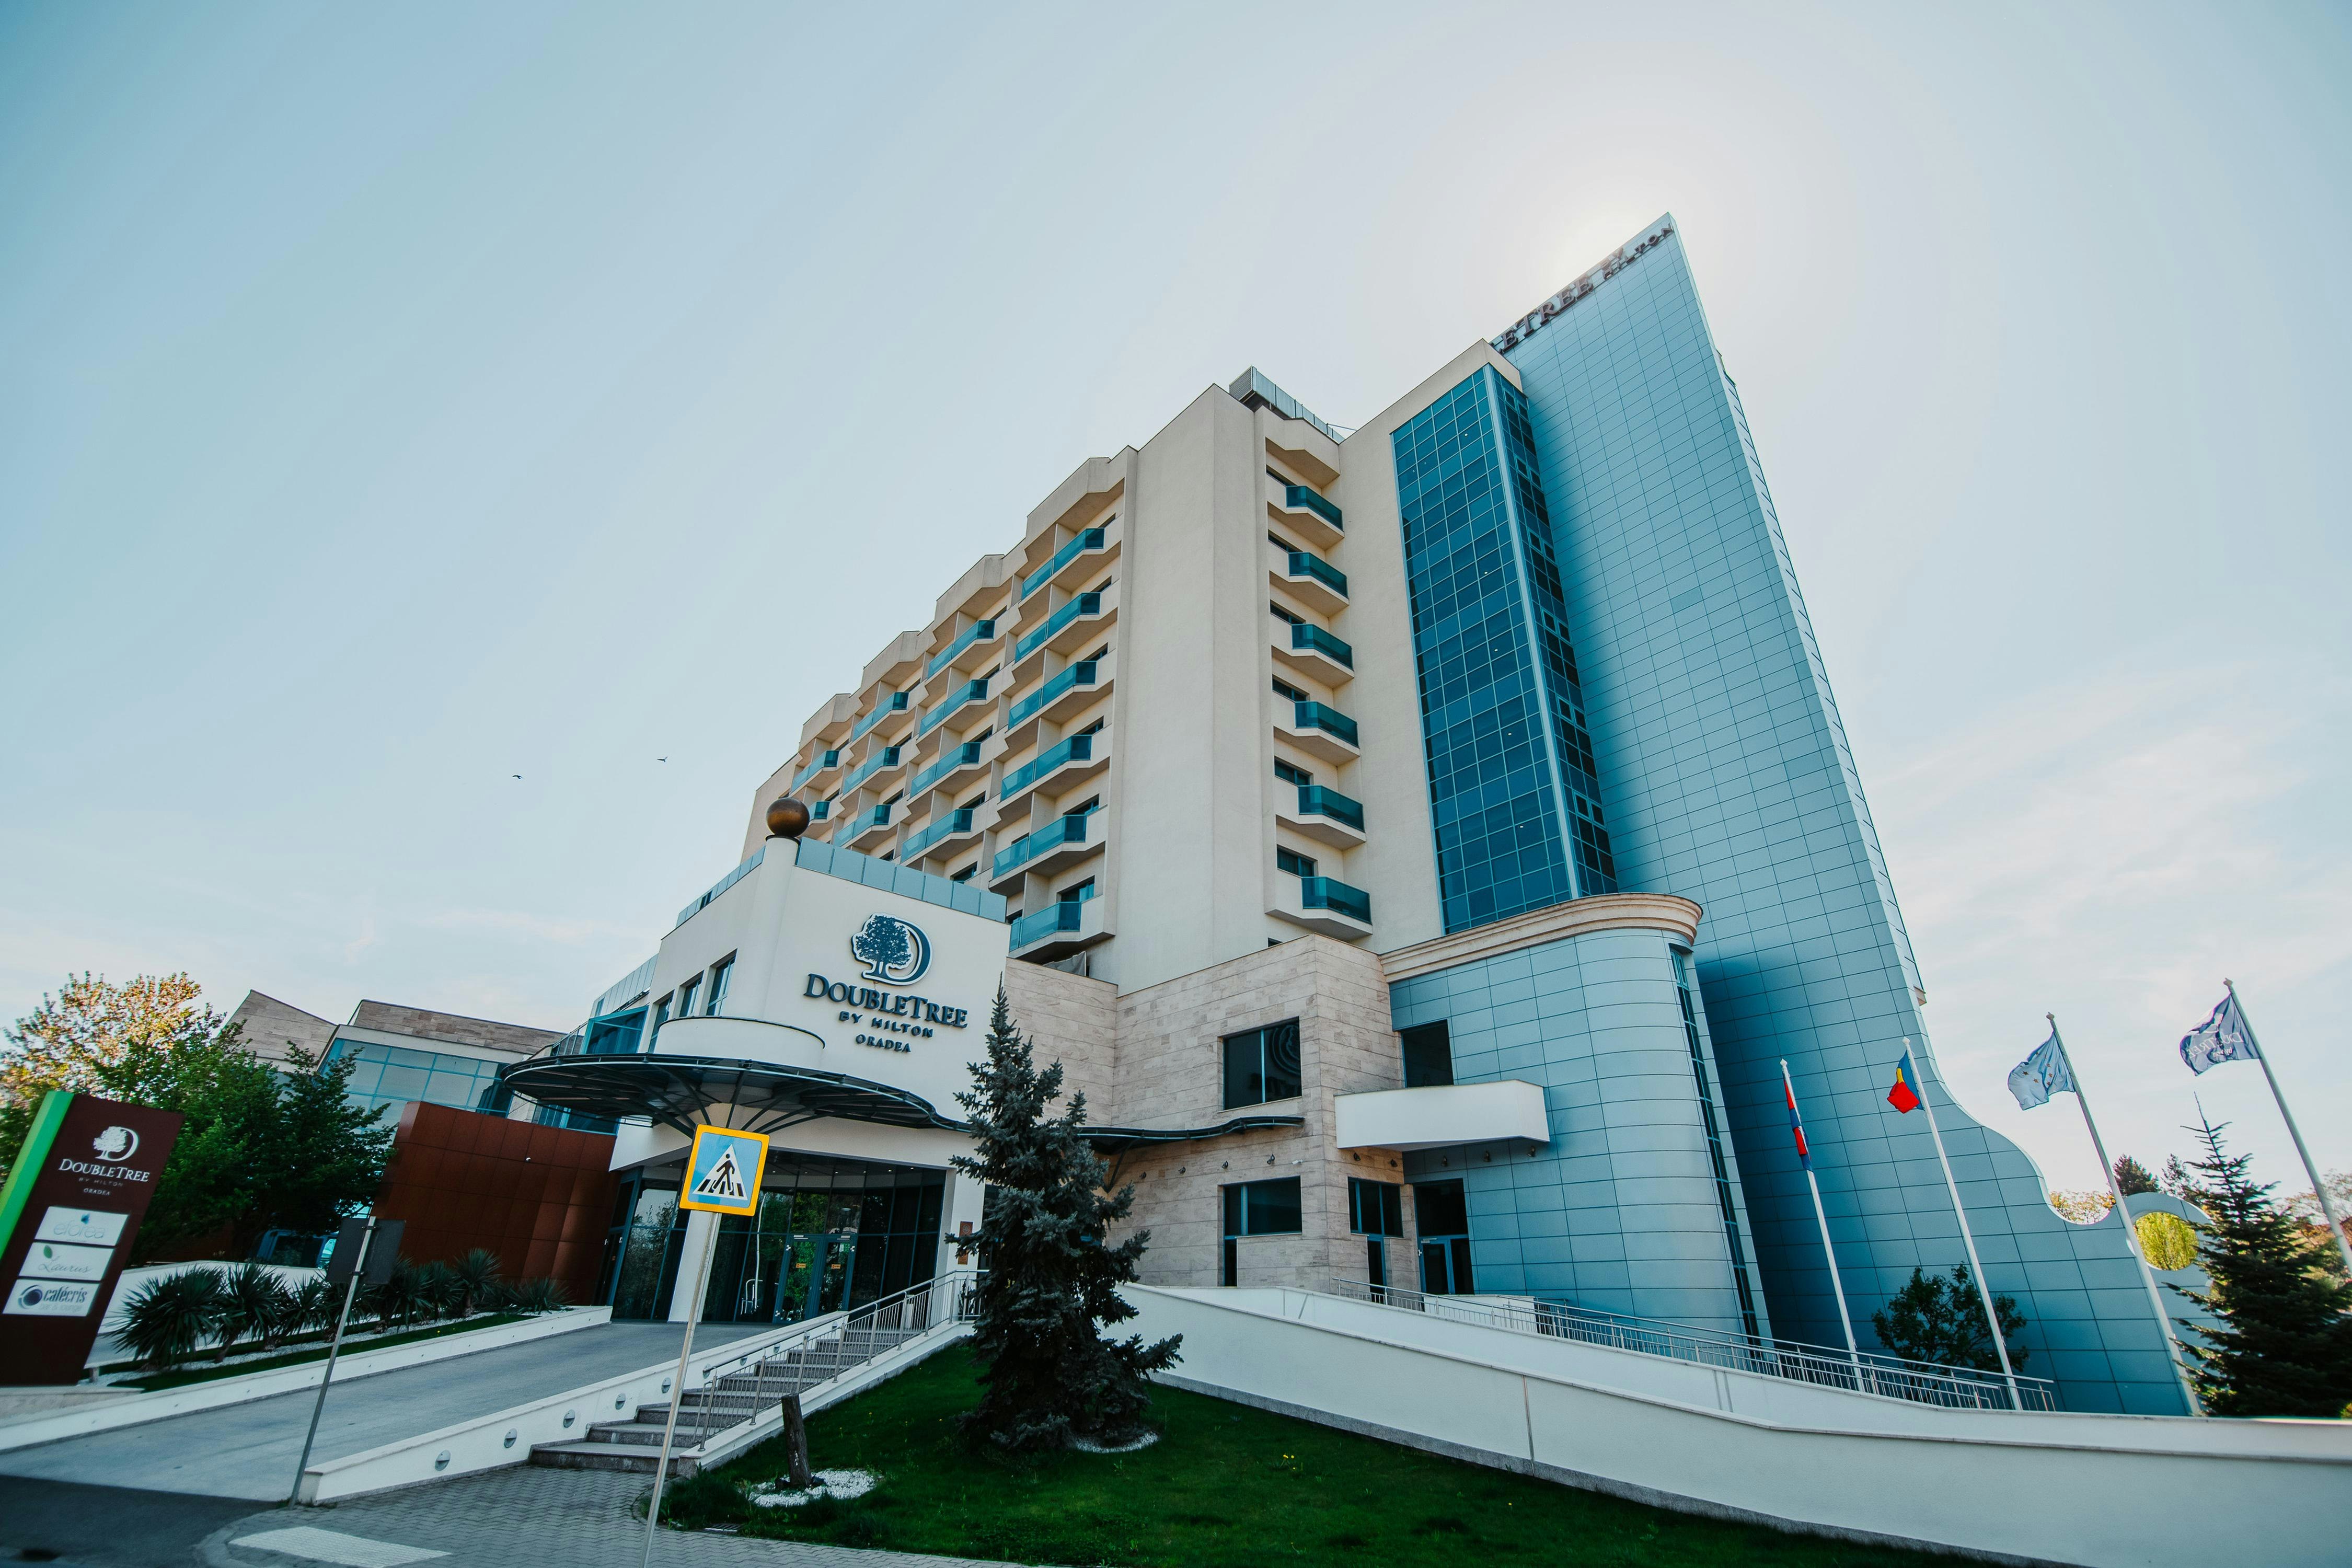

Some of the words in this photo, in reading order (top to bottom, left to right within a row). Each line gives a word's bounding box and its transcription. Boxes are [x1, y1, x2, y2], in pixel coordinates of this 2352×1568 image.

[803, 973, 968, 1029] DOUBLETREE
[839, 1011, 862, 1023] BY
[871, 1017, 933, 1037] HILTON
[856, 1034, 911, 1053] ORADEA
[59, 1158, 150, 1182] DOUBLETREE
[84, 1187, 110, 1196] ORADEA
[54, 1220, 105, 1239] eforea
[38, 1256, 93, 1273] Laurus
